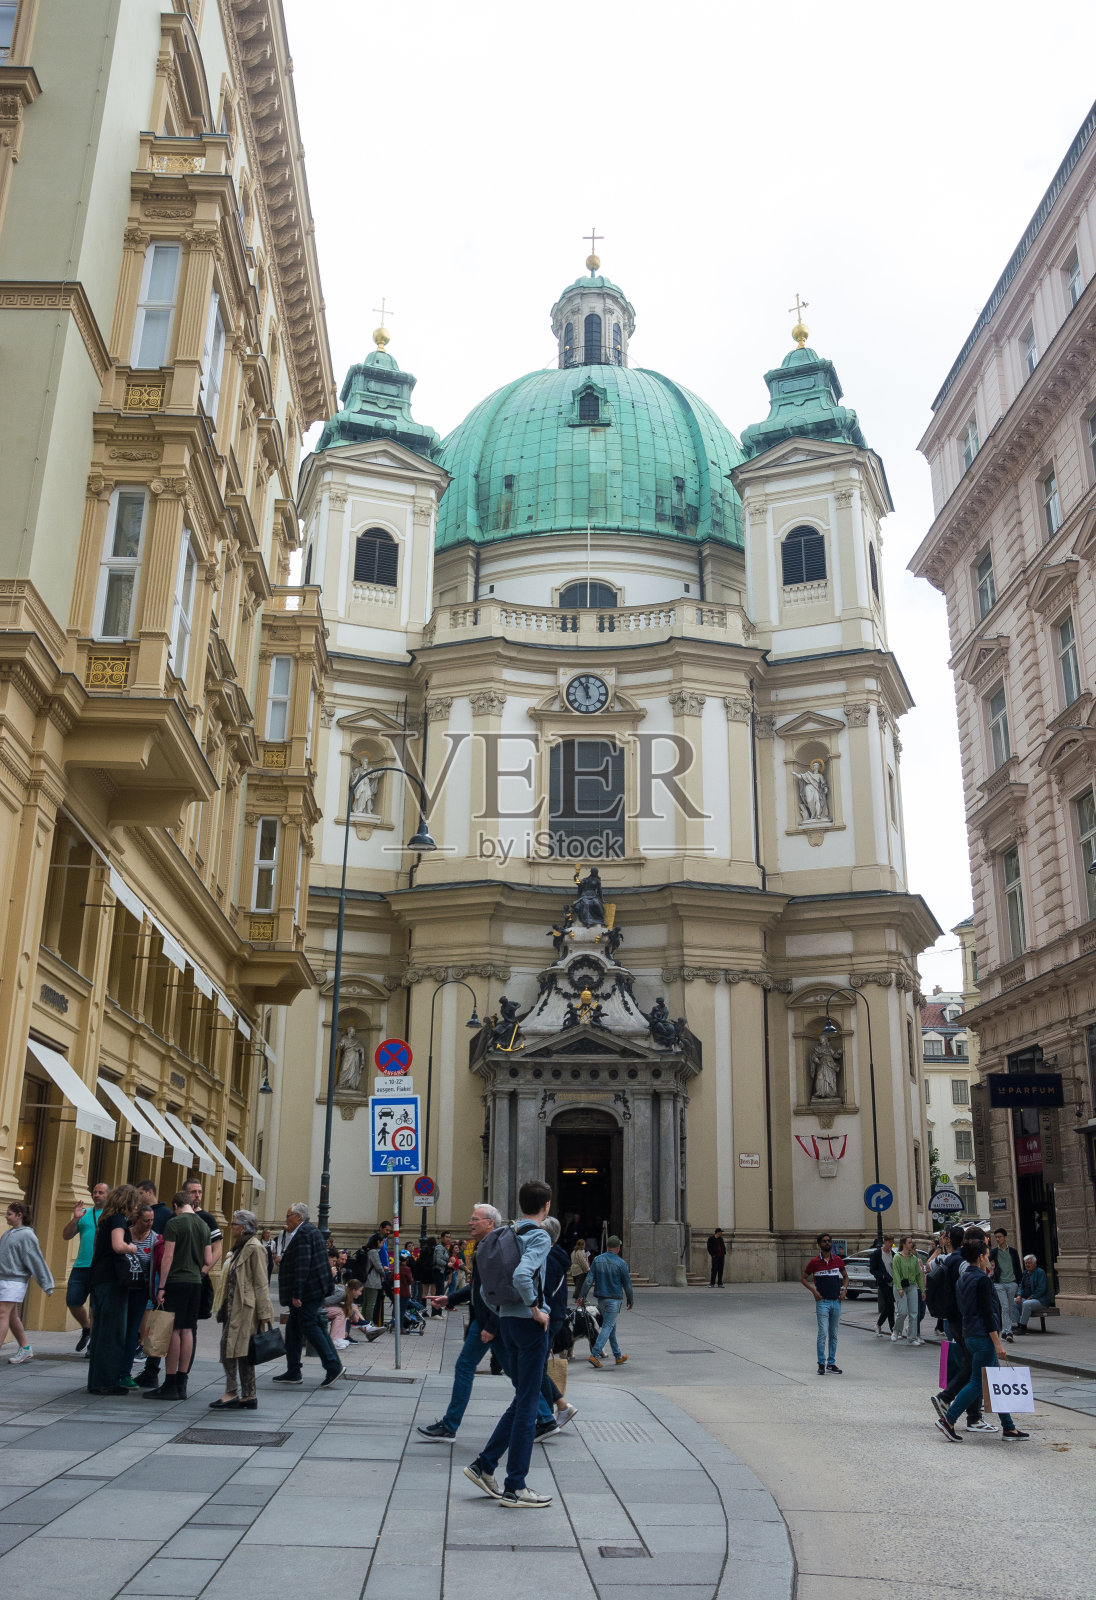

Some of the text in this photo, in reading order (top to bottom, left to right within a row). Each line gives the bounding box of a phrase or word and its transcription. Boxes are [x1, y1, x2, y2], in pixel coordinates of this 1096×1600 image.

[1008, 1086, 1055, 1095] PARFUM
[399, 1133, 413, 1147] 20
[992, 1383, 1029, 1395] BOSS
